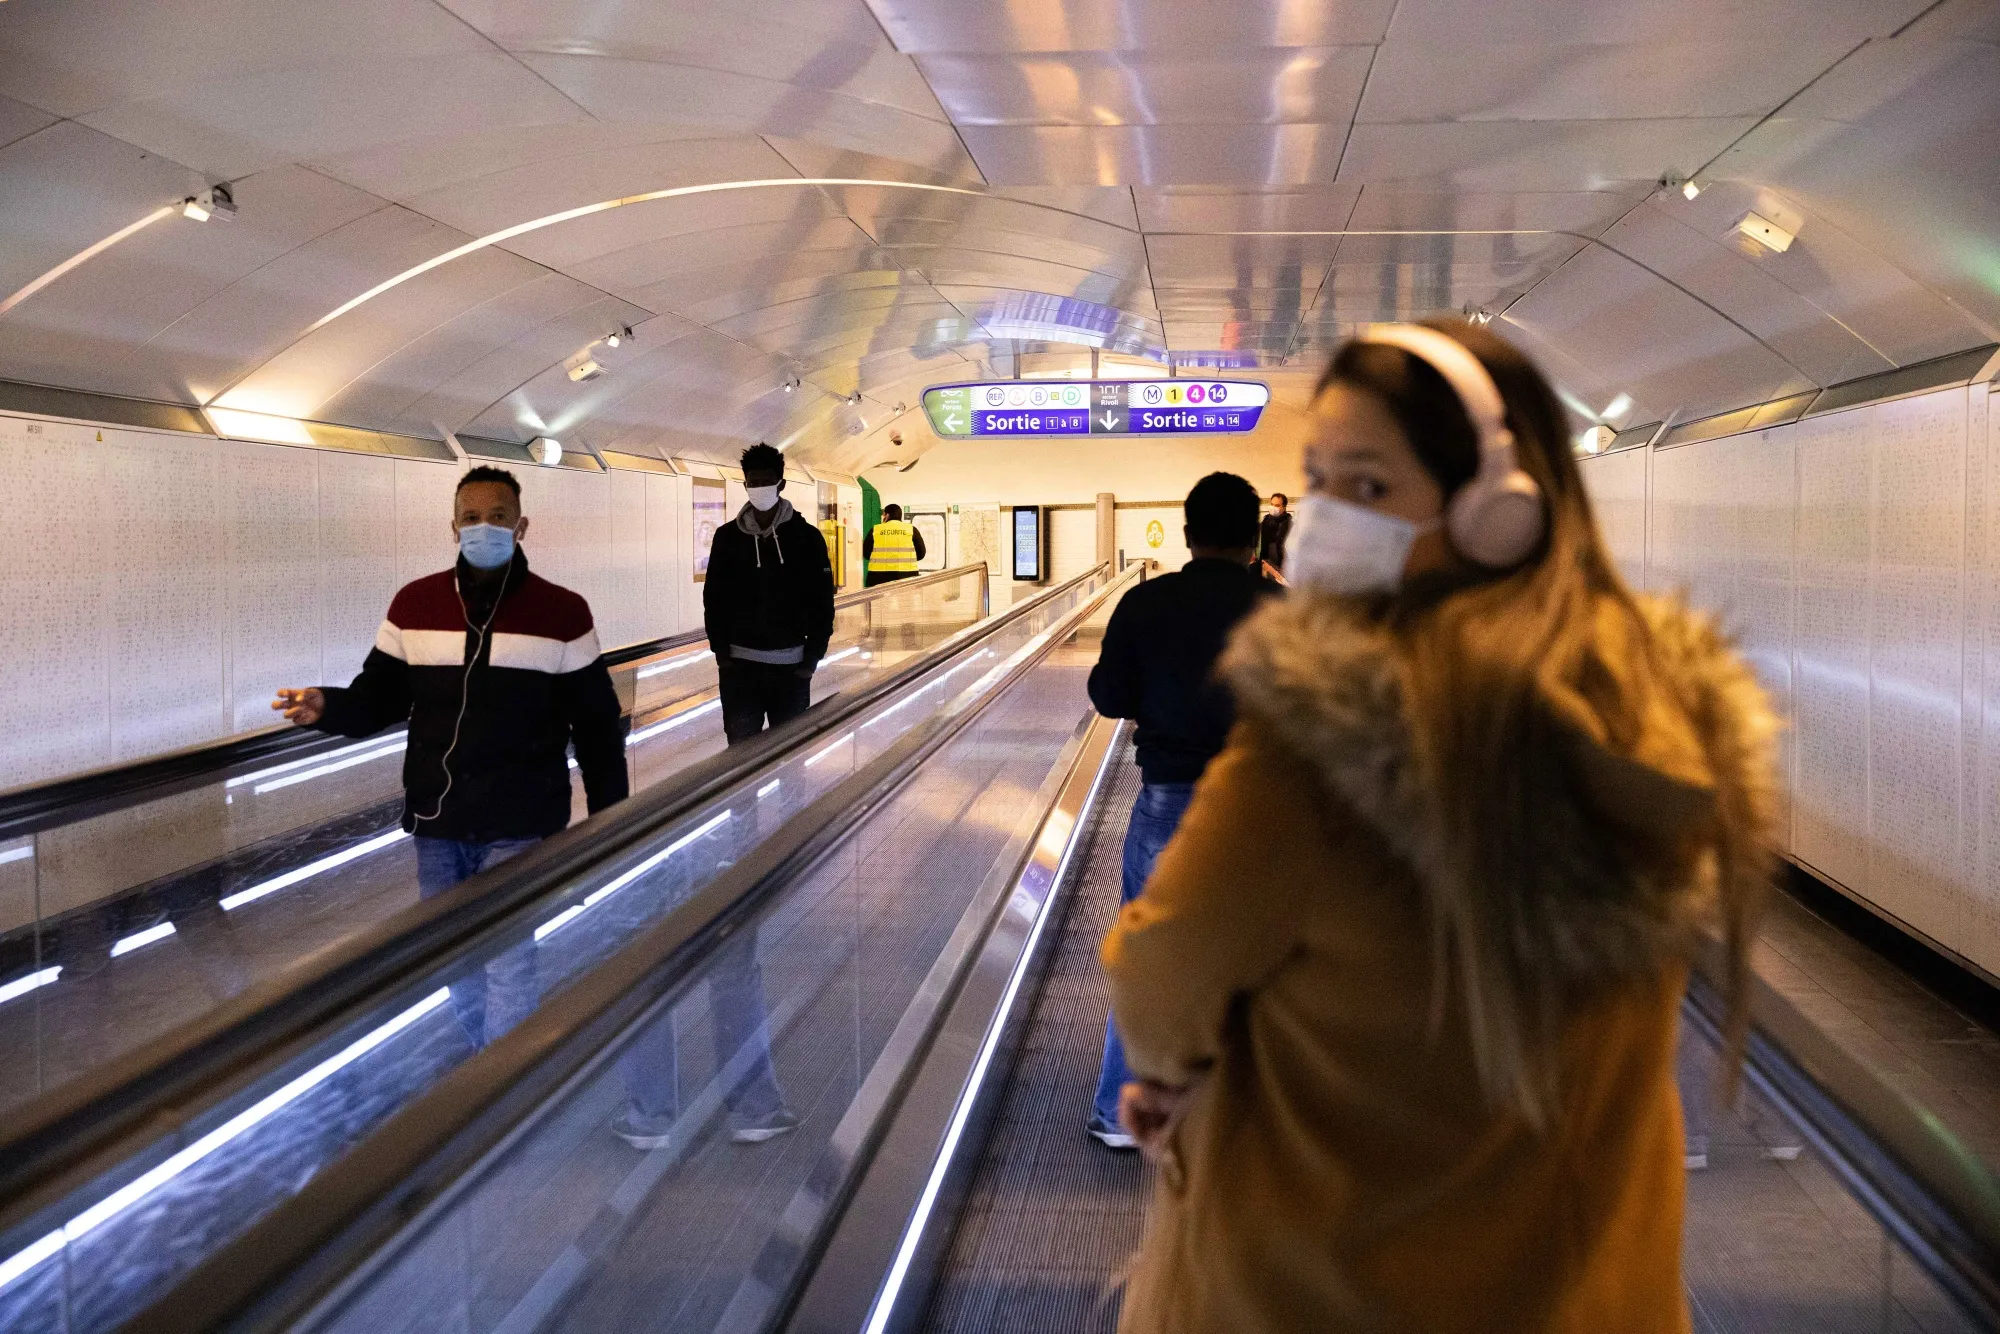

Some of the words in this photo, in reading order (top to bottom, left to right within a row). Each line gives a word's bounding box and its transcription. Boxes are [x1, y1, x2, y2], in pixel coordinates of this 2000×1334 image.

[988, 393, 1003, 401] RER
[1147, 389, 1157, 400] M
[1190, 388, 1201, 400] 4
[1209, 387, 1226, 400] 14
[986, 414, 1040, 430] Sortie
[1143, 412, 1198, 428] Sortie
[1205, 417, 1215, 425] 10
[1228, 416, 1238, 425] 14
